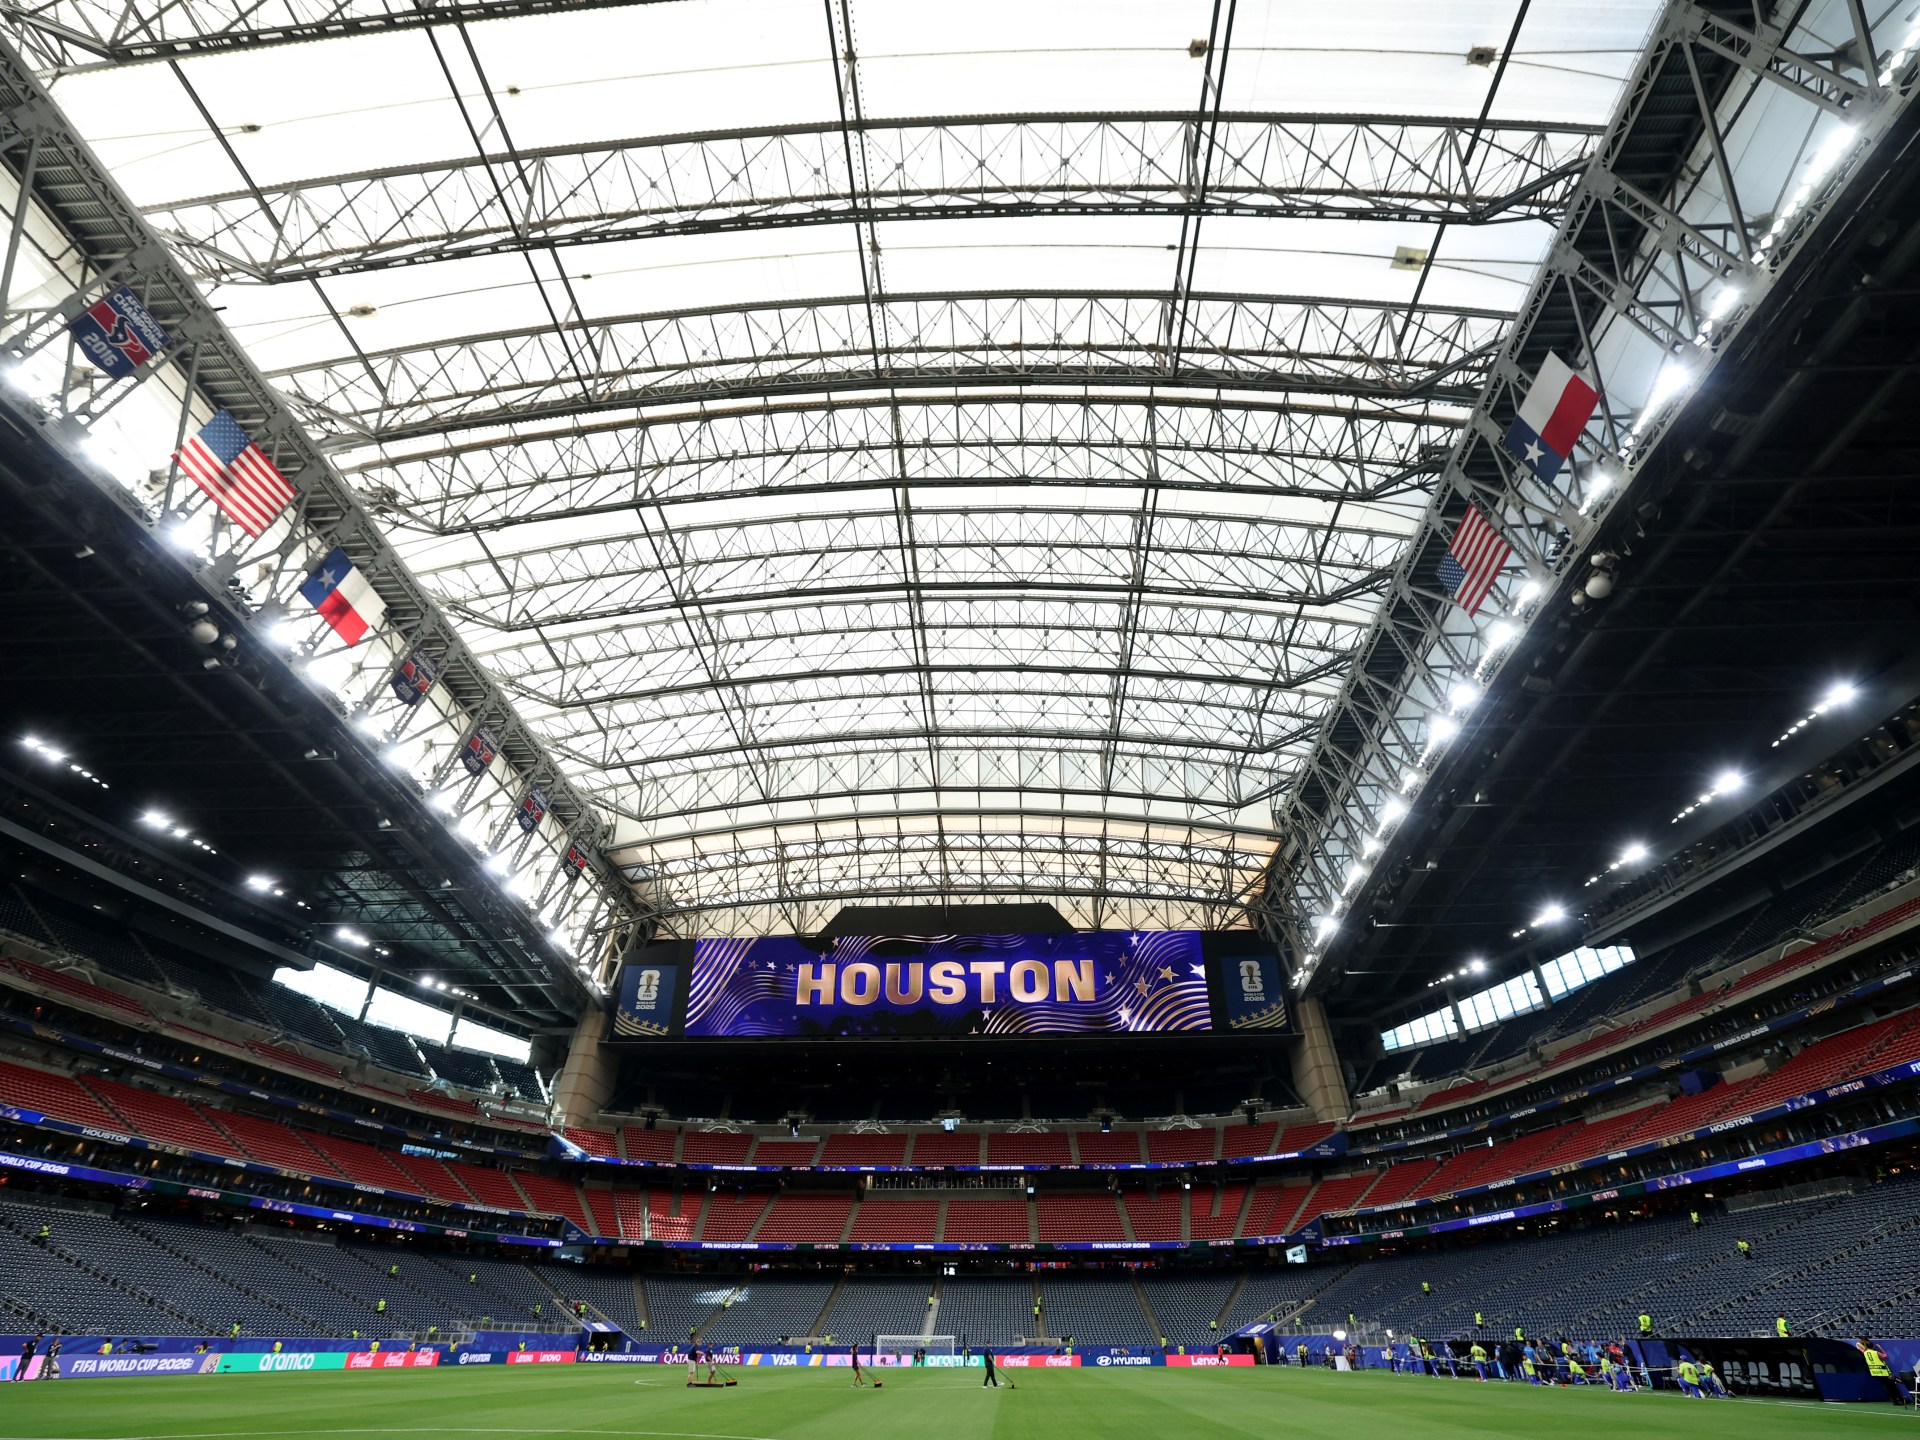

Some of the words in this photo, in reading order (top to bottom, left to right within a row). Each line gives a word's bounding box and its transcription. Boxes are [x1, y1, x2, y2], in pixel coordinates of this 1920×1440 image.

[113, 293, 162, 350] CHAMPIONS
[126, 295, 142, 313] AFC
[140, 311, 165, 339] SOUTH
[82, 332, 118, 367] 2016
[796, 959, 1096, 1005] HOUSTON
[1713, 1042, 1724, 1051] FIFA
[1723, 1036, 1741, 1047] WORLD
[1740, 1032, 1751, 1041] CUP
[1750, 1025, 1769, 1037] 2026
[115, 1051, 134, 1061] WORLD
[133, 1056, 145, 1064] CUP
[1826, 1080, 1865, 1097] HOUSTON
[1510, 1107, 1536, 1119] HOUSTON
[354, 1118, 384, 1130] HOUSTON
[1709, 1115, 1753, 1133] HOUSTON
[82, 1127, 130, 1143] HOUSTON
[24, 1160, 42, 1170] CUP
[40, 1162, 69, 1174] 2026
[353, 1184, 385, 1195] HOUSTON
[1488, 1178, 1515, 1190] HOUSTON
[1491, 1213, 1500, 1221] CUP
[259, 1352, 315, 1371] aramco
[350, 1352, 376, 1368] Coca-Cola
[384, 1352, 407, 1367] Coca-Cola
[414, 1352, 435, 1366] Coca-Cola
[468, 1353, 491, 1363] HYUNDAI
[515, 1352, 533, 1363] Lenovo
[539, 1352, 561, 1362] Lenovo
[585, 1353, 604, 1362] ADI
[663, 1353, 689, 1365] QATA
[771, 1354, 797, 1365] VISA
[1003, 1355, 1030, 1367] Coca-Cola
[1045, 1355, 1072, 1367] Coca-Cola
[1113, 1356, 1150, 1365] HYUNDAI
[71, 1359, 97, 1373] FIFA
[98, 1359, 137, 1372] WORLD
[136, 1358, 159, 1371] CUP
